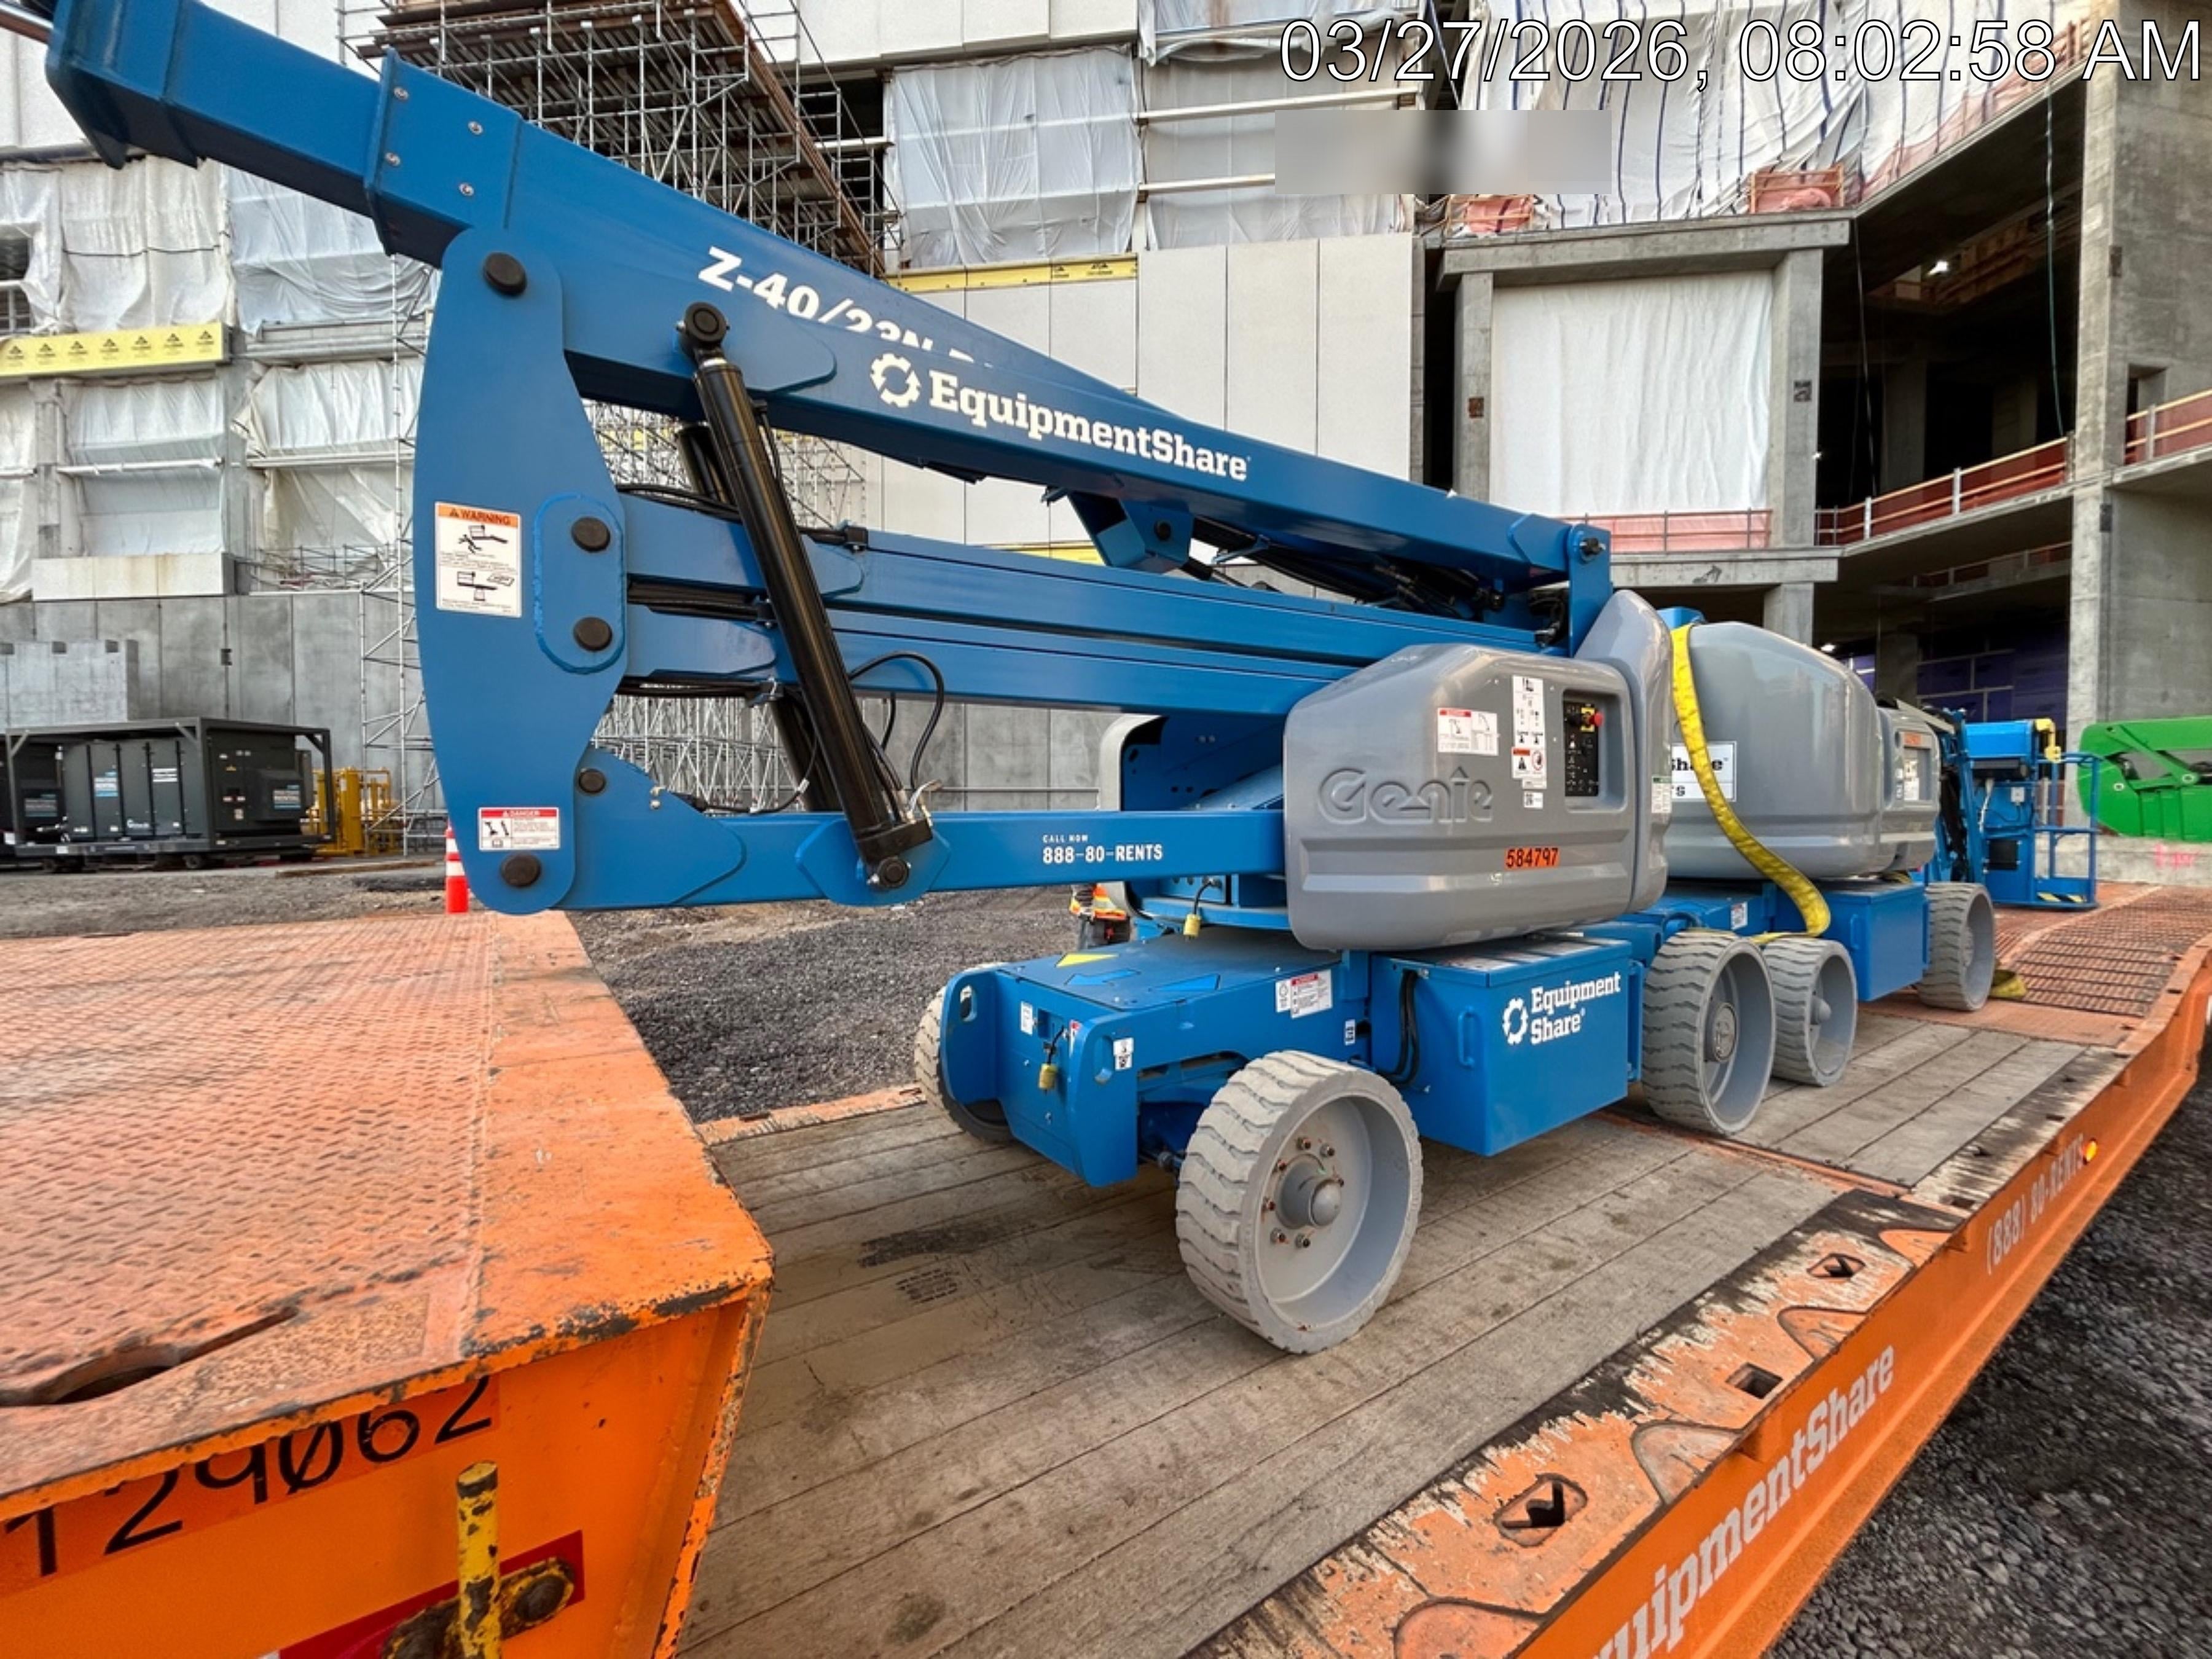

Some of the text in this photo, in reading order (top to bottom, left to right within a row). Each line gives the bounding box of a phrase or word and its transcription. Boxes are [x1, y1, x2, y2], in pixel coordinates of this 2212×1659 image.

[929, 369, 1248, 482] EquipmentShare
[461, 509, 511, 525] WARNING
[1318, 766, 1493, 825] Genie
[1042, 834, 1089, 843] CALL NOW
[1042, 844, 1163, 865] 888-80-RENTS
[1506, 847, 1559, 868] 584797
[1531, 971, 1622, 1015] Equipment
[1531, 1013, 1581, 1045] Share
[1986, 1194, 2026, 1276] (888)
